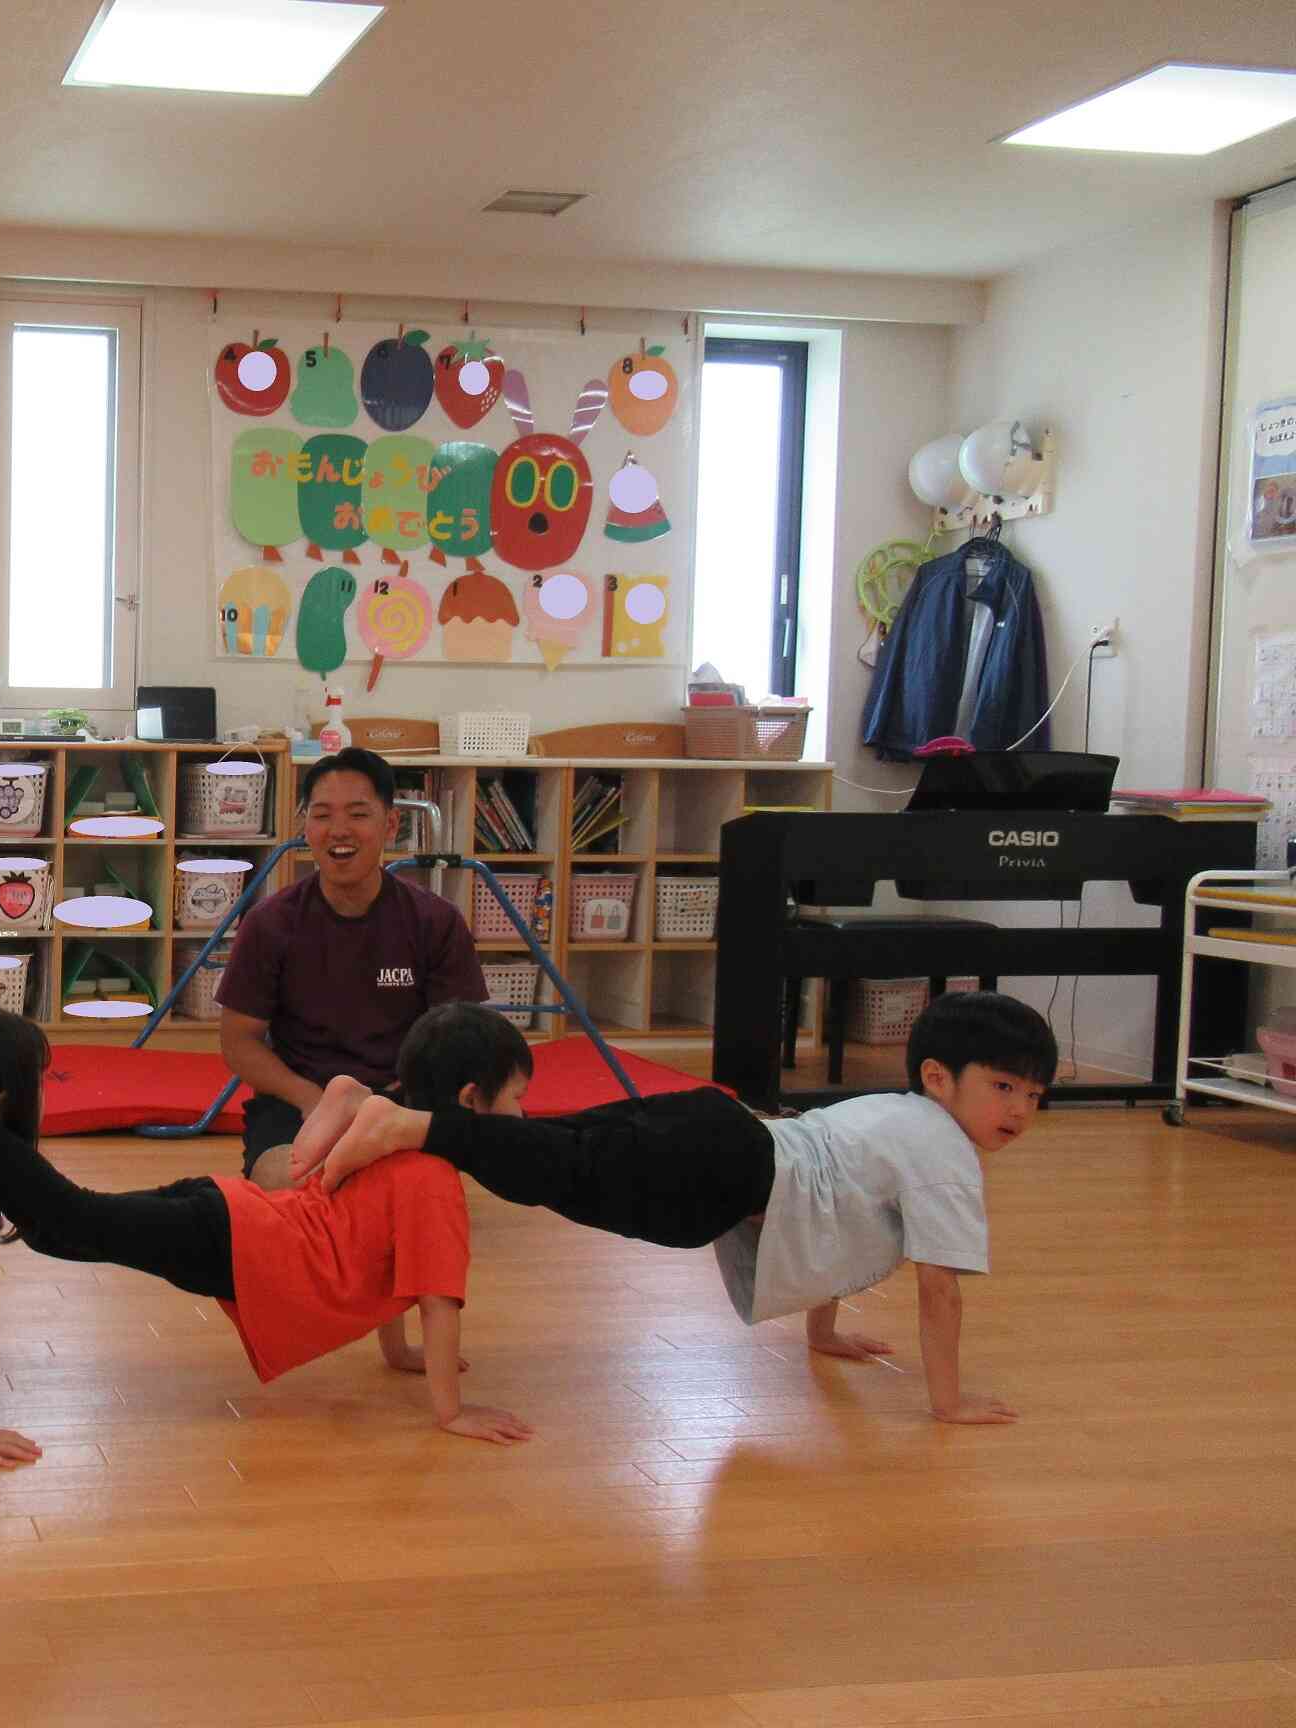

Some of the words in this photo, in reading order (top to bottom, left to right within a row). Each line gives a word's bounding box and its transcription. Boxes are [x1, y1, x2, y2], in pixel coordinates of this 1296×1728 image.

[305, 351, 317, 367] 5
[622, 357, 634, 374] 8
[250, 450, 452, 492] おたんじょうび
[333, 502, 480, 541] おめでとう
[340, 579, 353, 593] 11
[374, 579, 390, 595] 12
[532, 574, 543, 588] 2
[607, 575, 618, 591] 3
[220, 608, 238, 622] 10
[989, 831, 1059, 846] CASIO
[376, 967, 414, 982] JACPA
